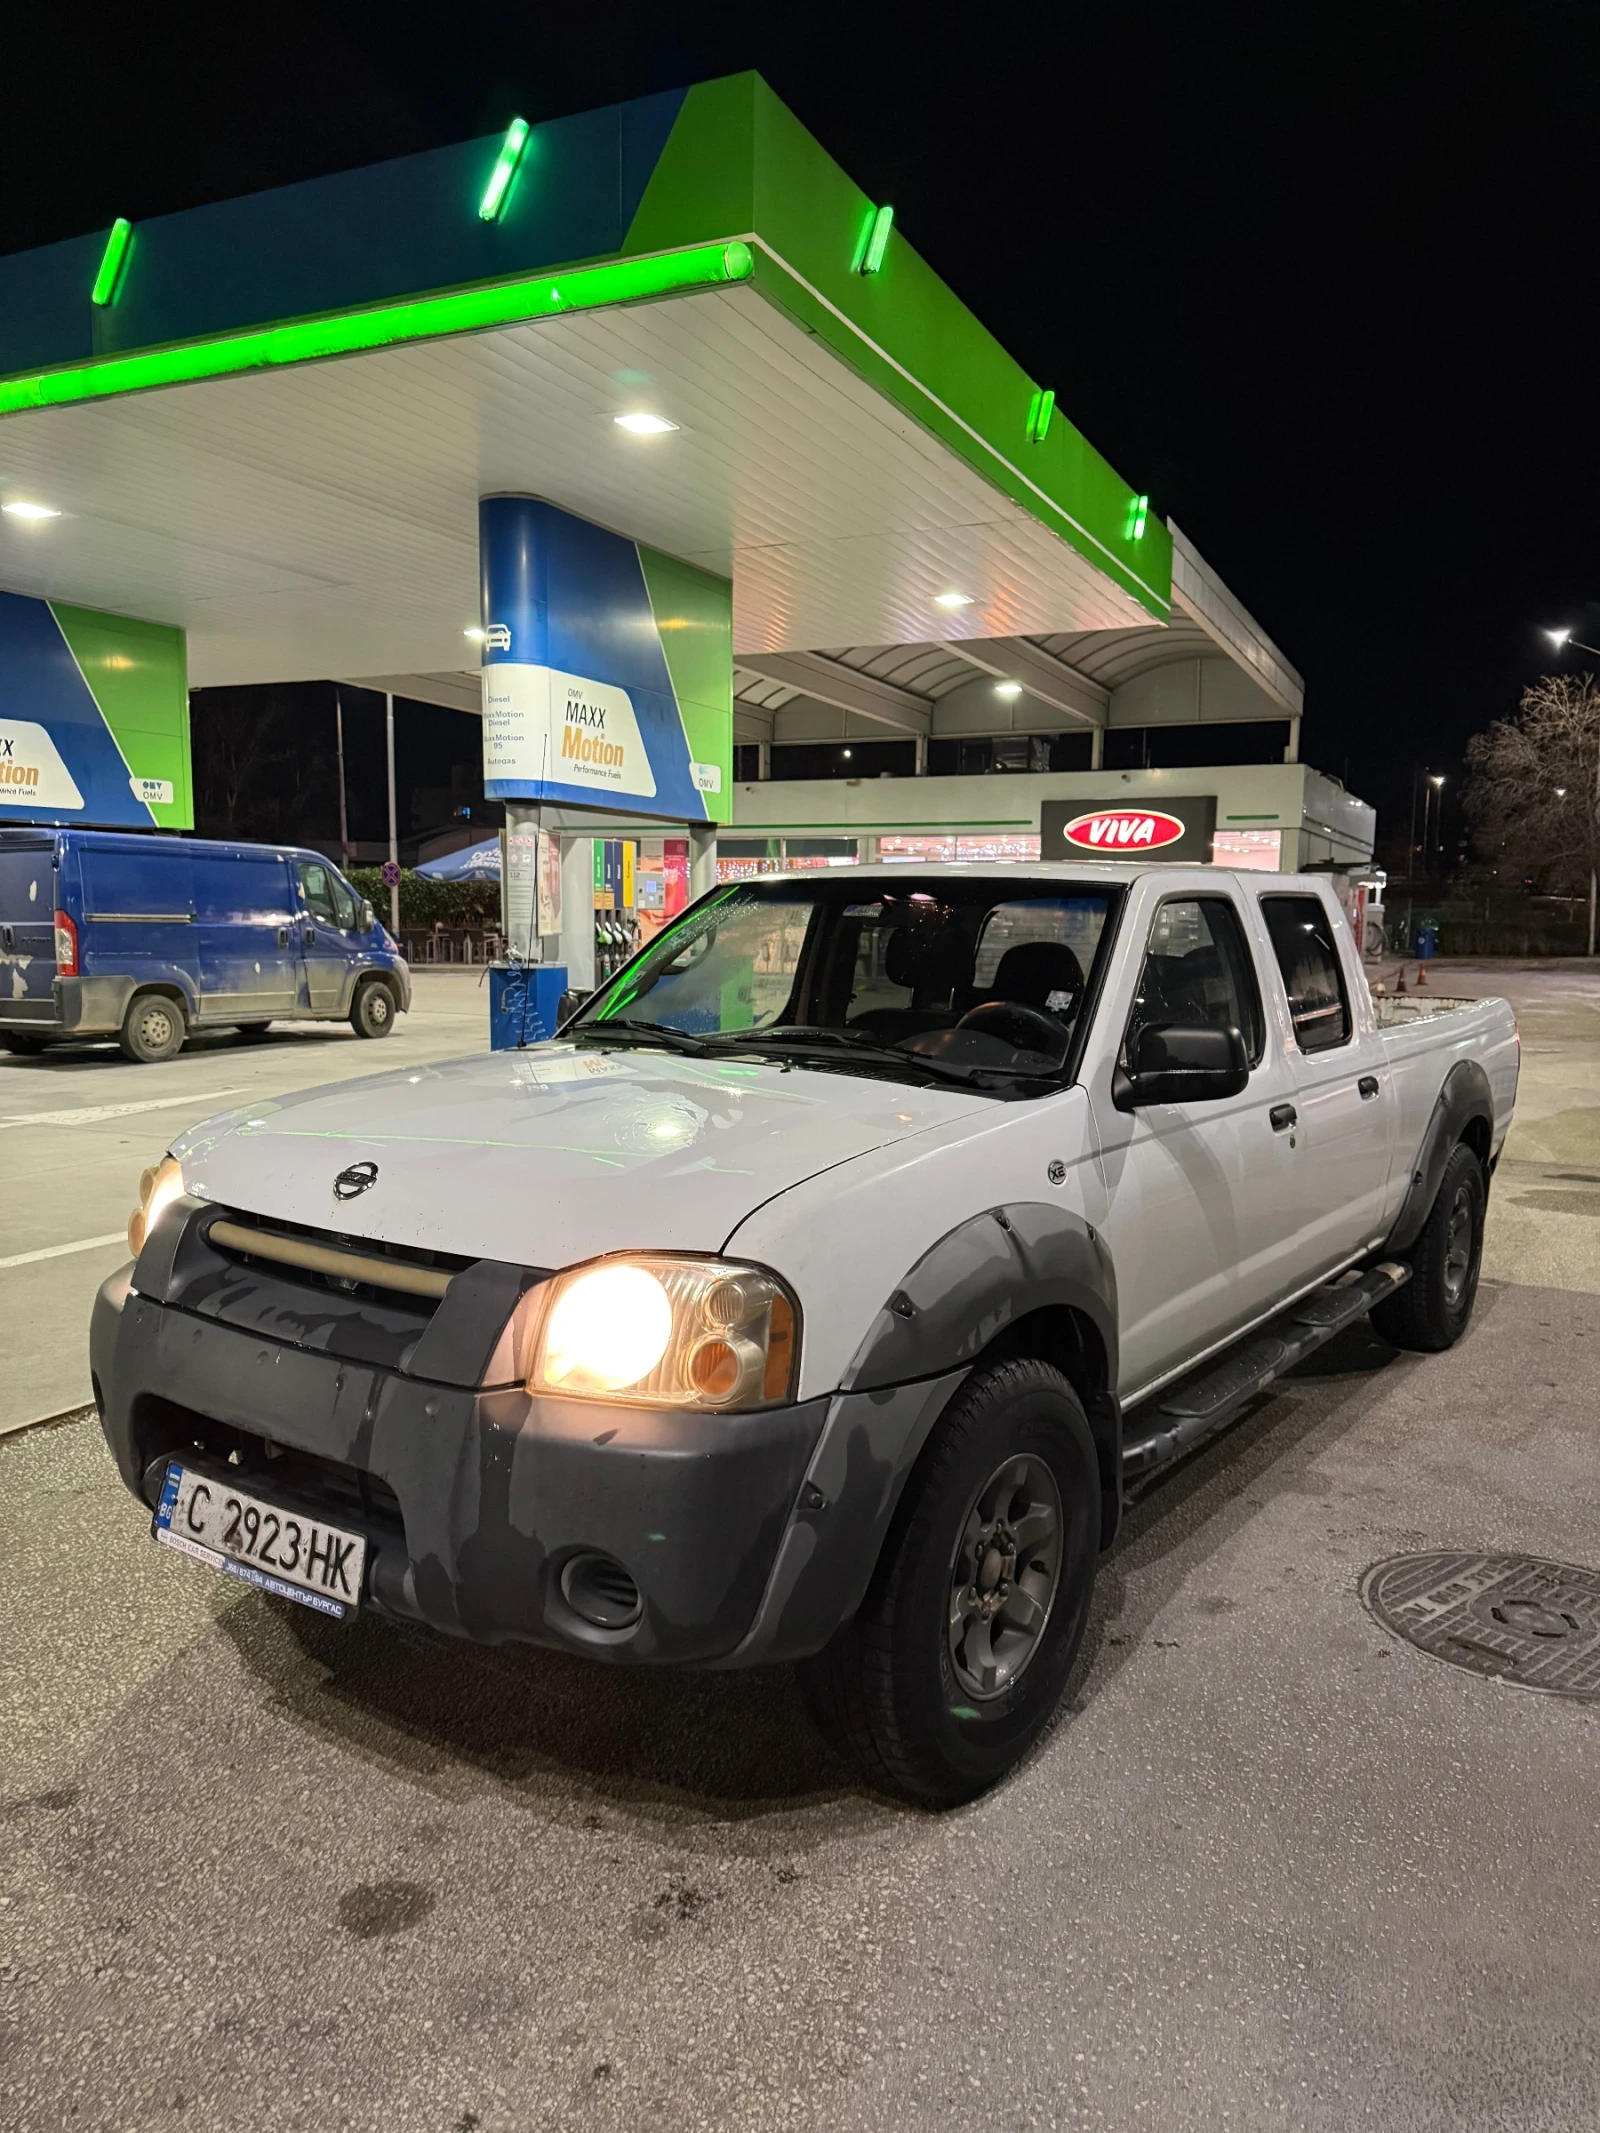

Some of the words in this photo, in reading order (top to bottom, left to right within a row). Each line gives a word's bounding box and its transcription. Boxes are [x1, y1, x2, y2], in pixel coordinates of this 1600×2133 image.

[567, 688, 583, 699] OMV
[565, 700, 606, 729] MAXX
[488, 719, 510, 727] Diesel
[493, 741, 503, 750] 95
[561, 725, 624, 767] Motion
[487, 757, 516, 766] Autogas
[574, 764, 607, 777] Performance
[608, 769, 621, 780] Fuels
[699, 778, 714, 789] OMV
[142, 791, 163, 800] OMV
[1089, 817, 1156, 844] VIVA
[1051, 1165, 1066, 1180] XE
[159, 1503, 173, 1520] BG
[170, 1536, 187, 1550] BOSCH
[187, 1544, 199, 1556] CAR
[199, 1550, 223, 1567] SERVICE
[265, 1579, 313, 1603] АВТОЦЕНТЪР
[312, 1596, 342, 1615] БУРГАС
